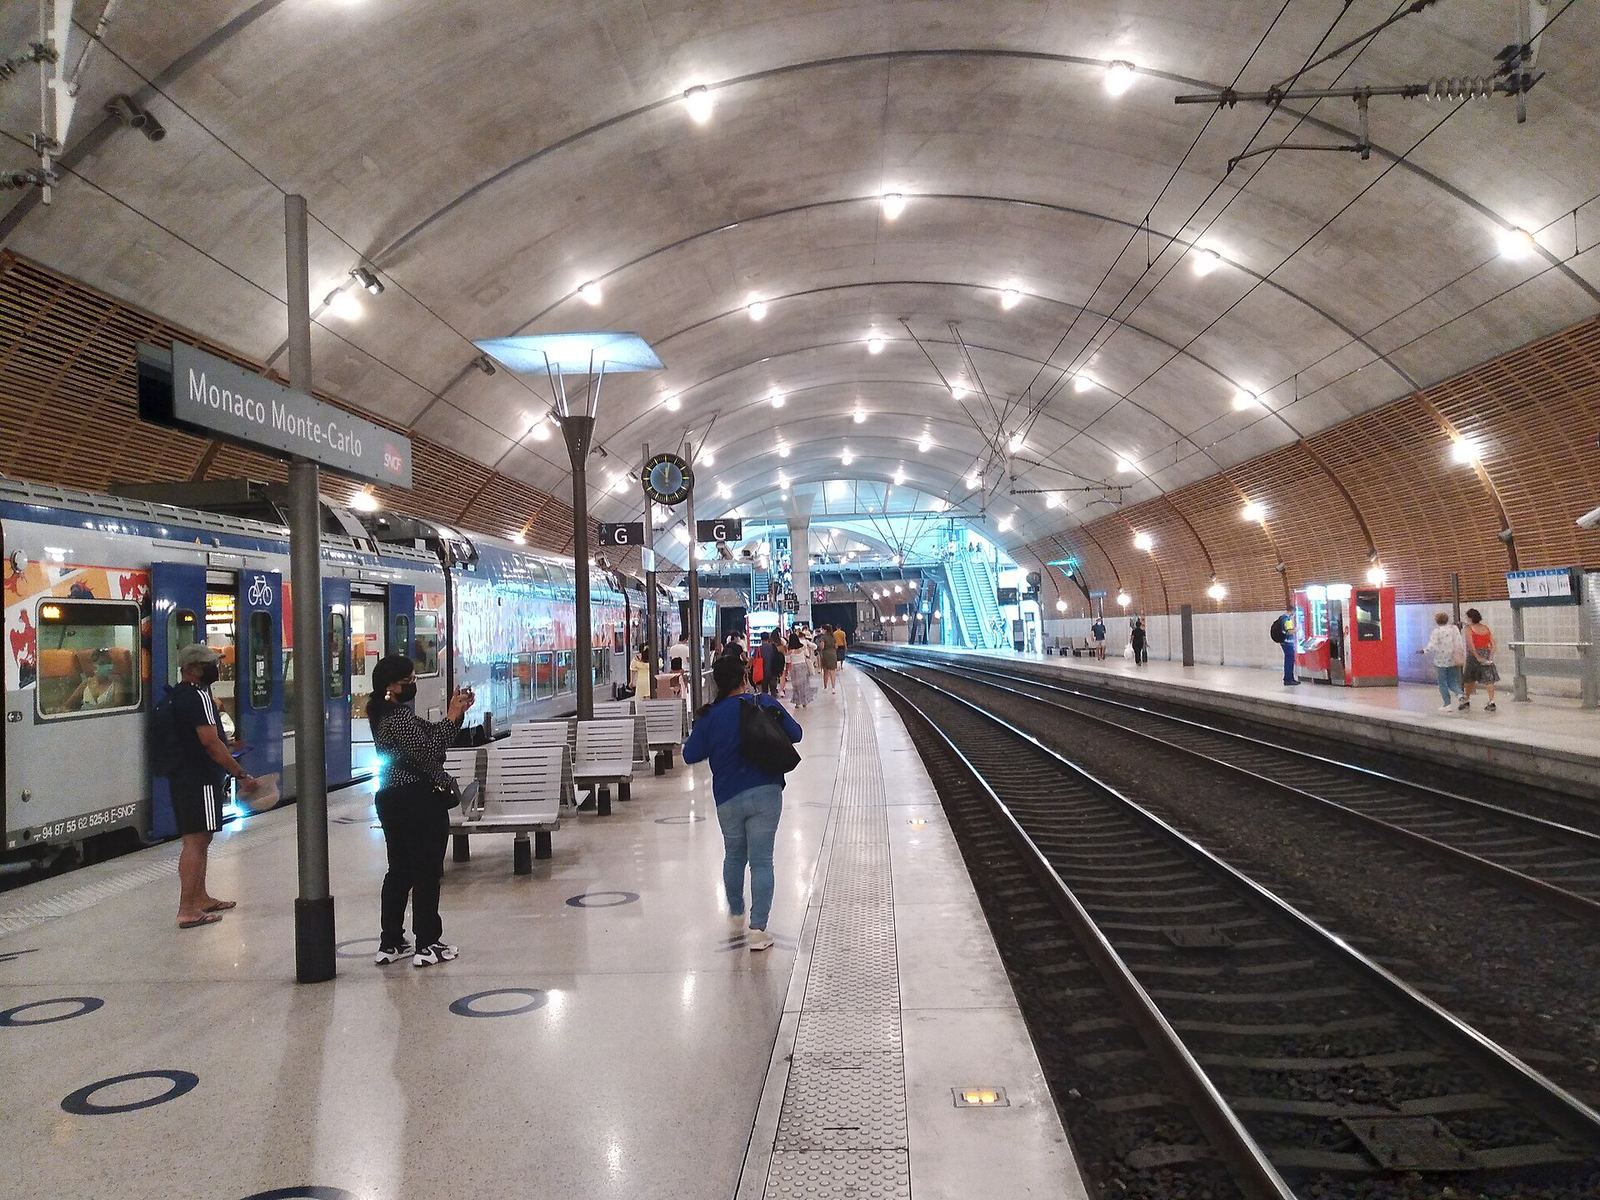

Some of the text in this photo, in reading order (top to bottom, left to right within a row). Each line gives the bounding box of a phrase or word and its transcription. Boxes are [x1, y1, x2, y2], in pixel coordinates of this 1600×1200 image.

[189, 368, 362, 458] Monaco Monte-Carlo
[614, 528, 628, 544] G
[713, 524, 727, 541] G
[42, 827, 53, 840] 94
[54, 823, 65, 836] 87
[66, 820, 77, 833] 55
[78, 817, 88, 830] 62
[89, 811, 109, 827] 525-8
